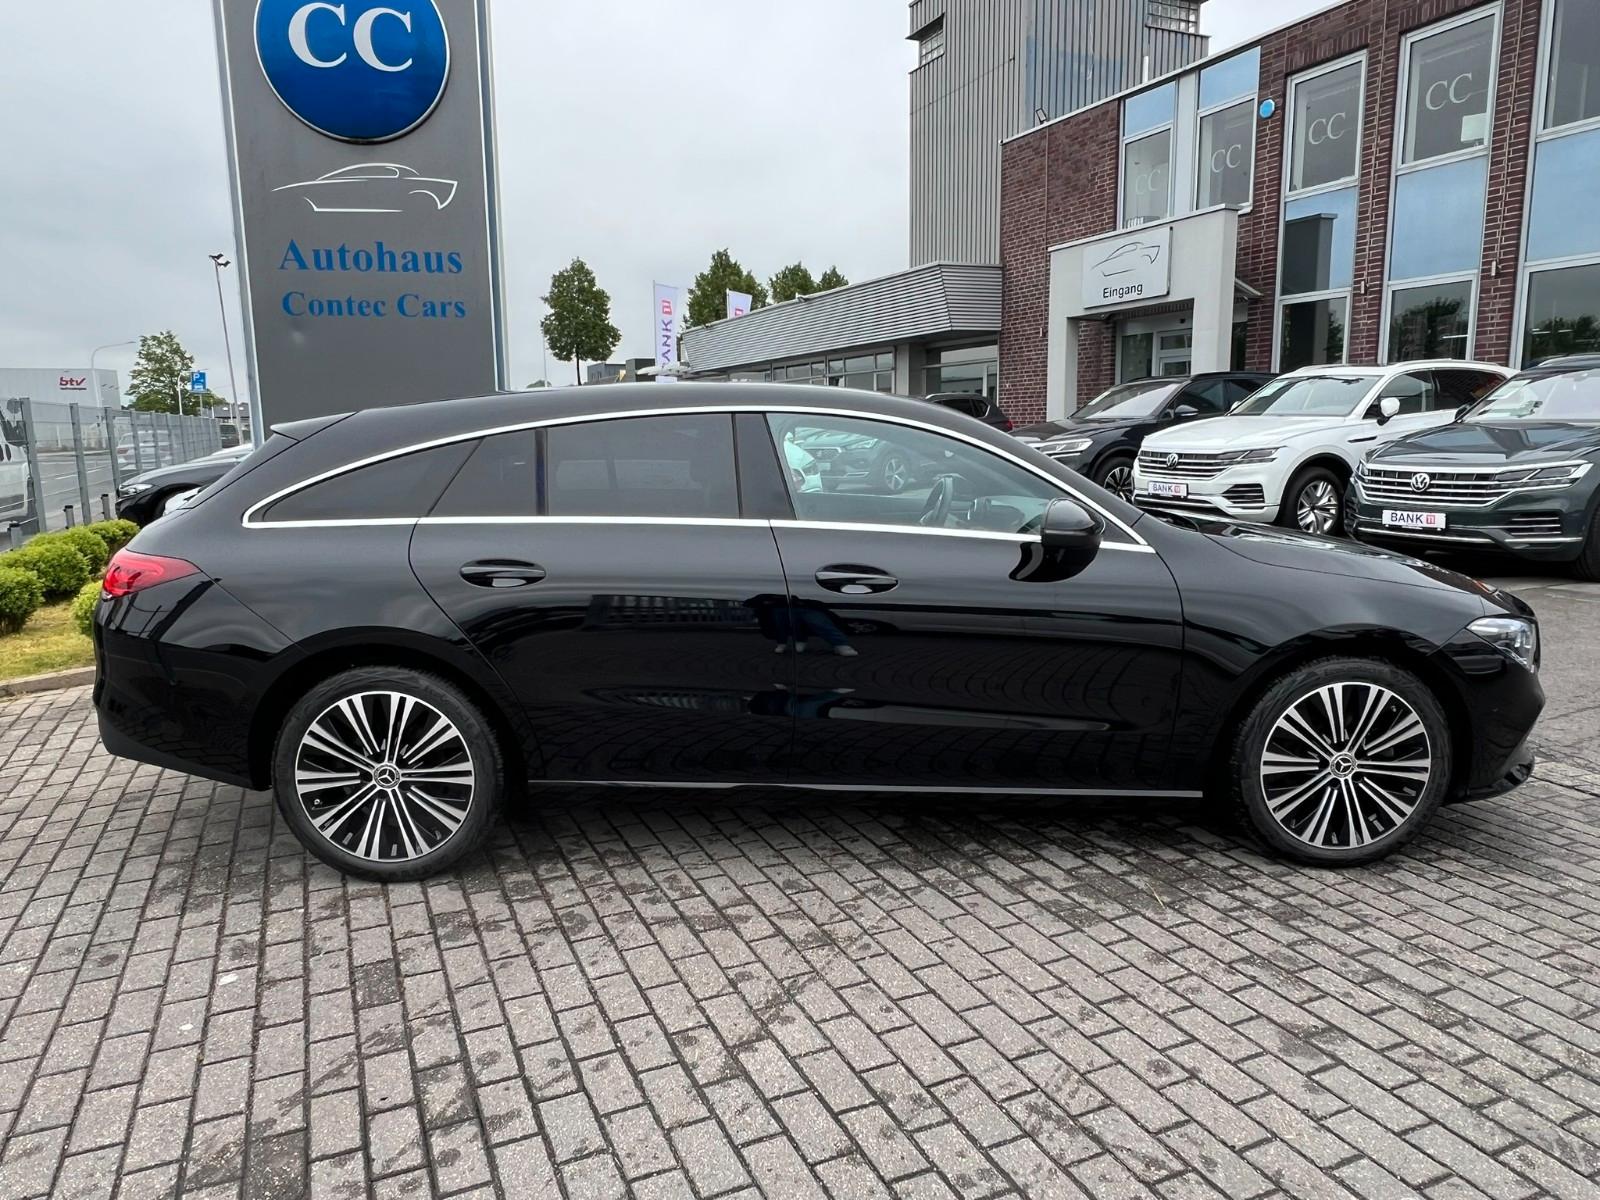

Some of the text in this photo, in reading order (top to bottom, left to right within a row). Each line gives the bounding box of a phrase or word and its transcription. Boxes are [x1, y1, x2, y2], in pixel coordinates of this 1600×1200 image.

[288, 2, 413, 72] CC
[1425, 73, 1472, 110] CC
[1308, 112, 1346, 145] CC
[1211, 144, 1241, 173] CC
[279, 239, 463, 274] Autohaus
[282, 291, 467, 318] Contec Cars
[1103, 284, 1143, 299] Eingang
[60, 376, 86, 386] btv
[1152, 483, 1173, 493] BANK
[1391, 512, 1423, 524] BANK
